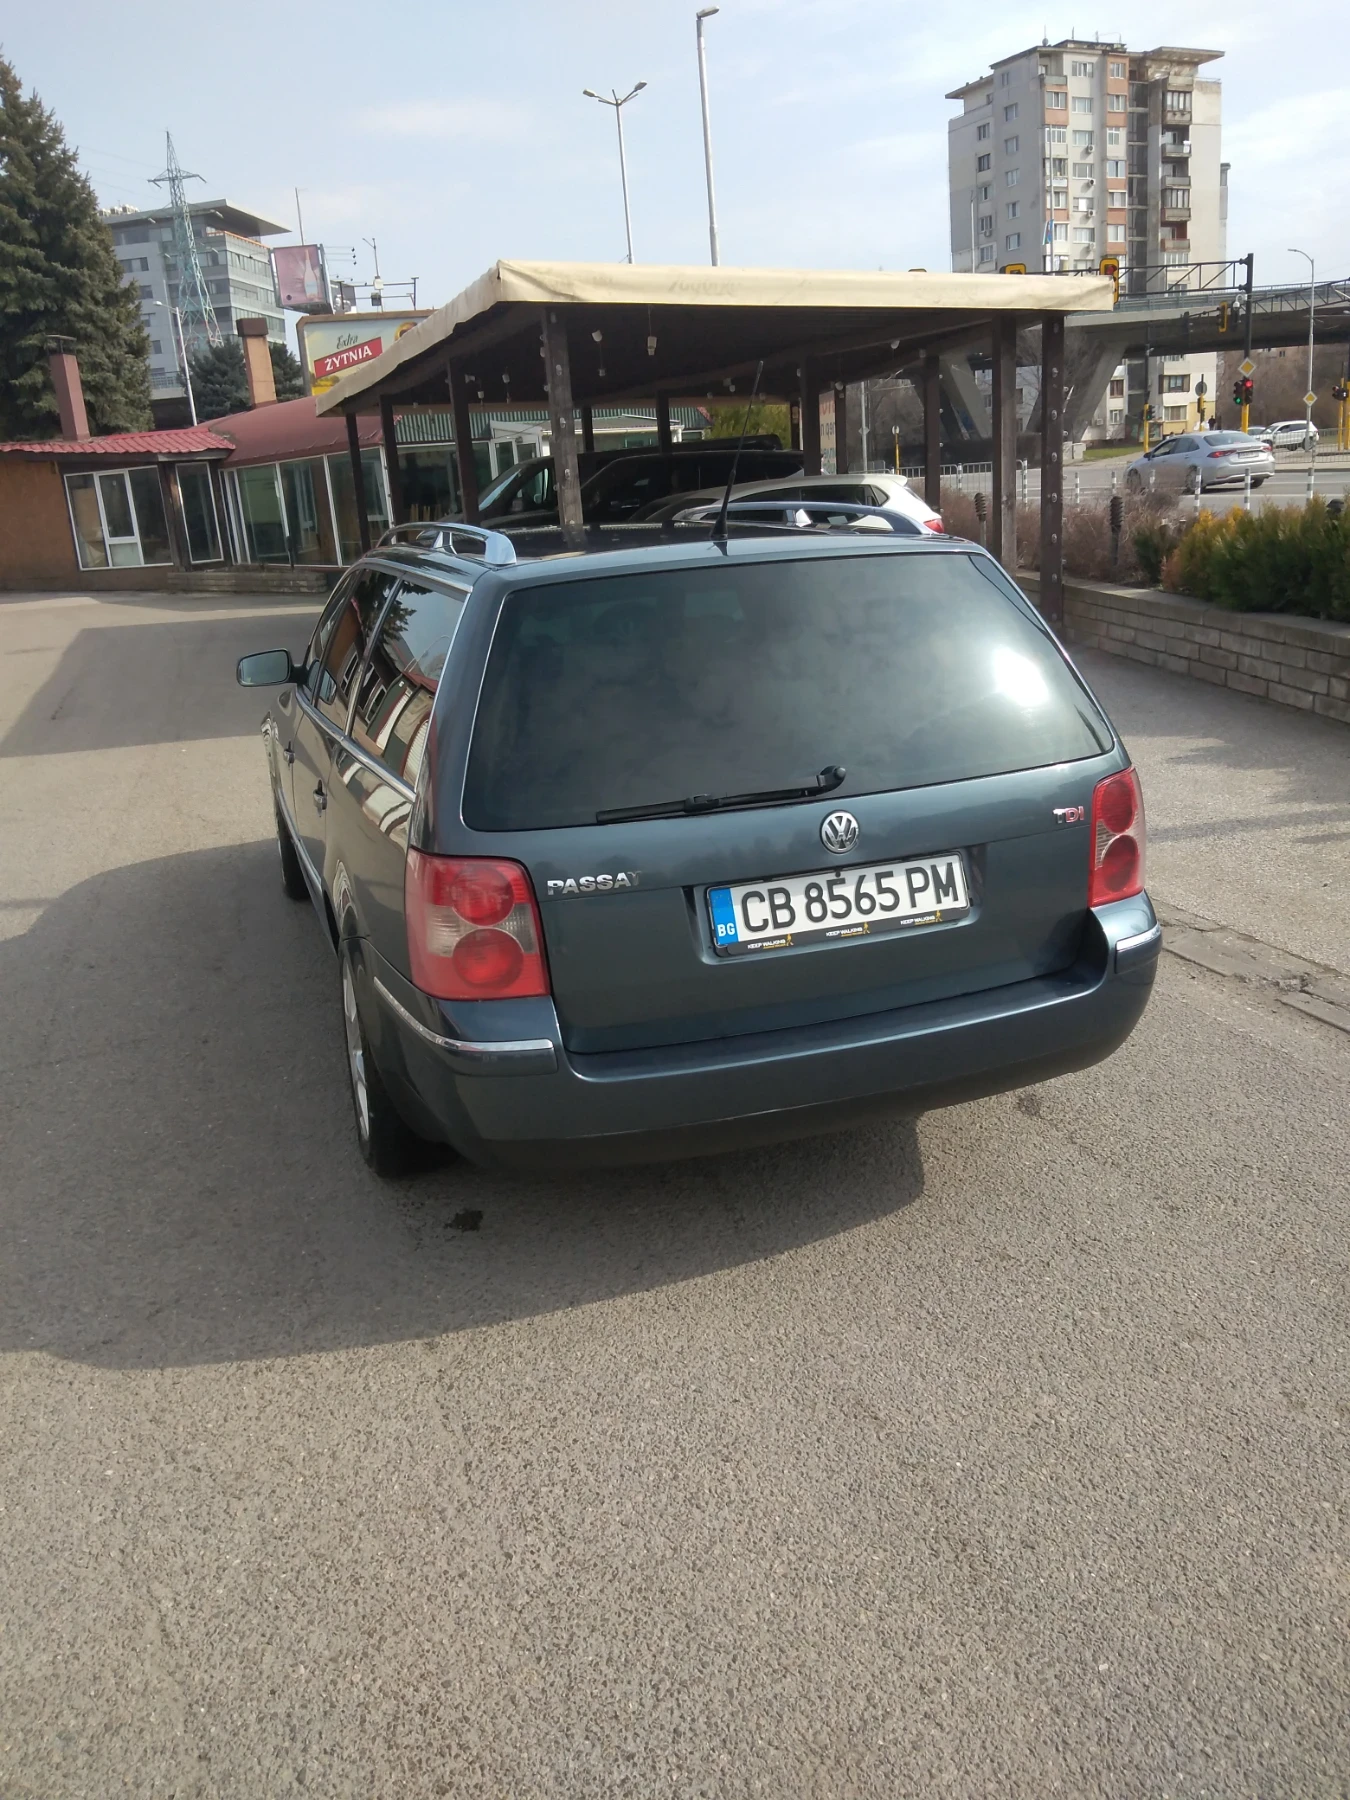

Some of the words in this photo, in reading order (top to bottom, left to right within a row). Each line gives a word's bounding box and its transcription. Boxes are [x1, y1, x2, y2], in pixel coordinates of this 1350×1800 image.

[336, 333, 359, 350] Extra
[324, 345, 373, 371] ŻYTNIA
[1053, 806, 1085, 824] TDI
[547, 870, 642, 896] PASSAT
[804, 871, 900, 923] 8565
[905, 862, 959, 908] PM
[717, 922, 736, 937] BG
